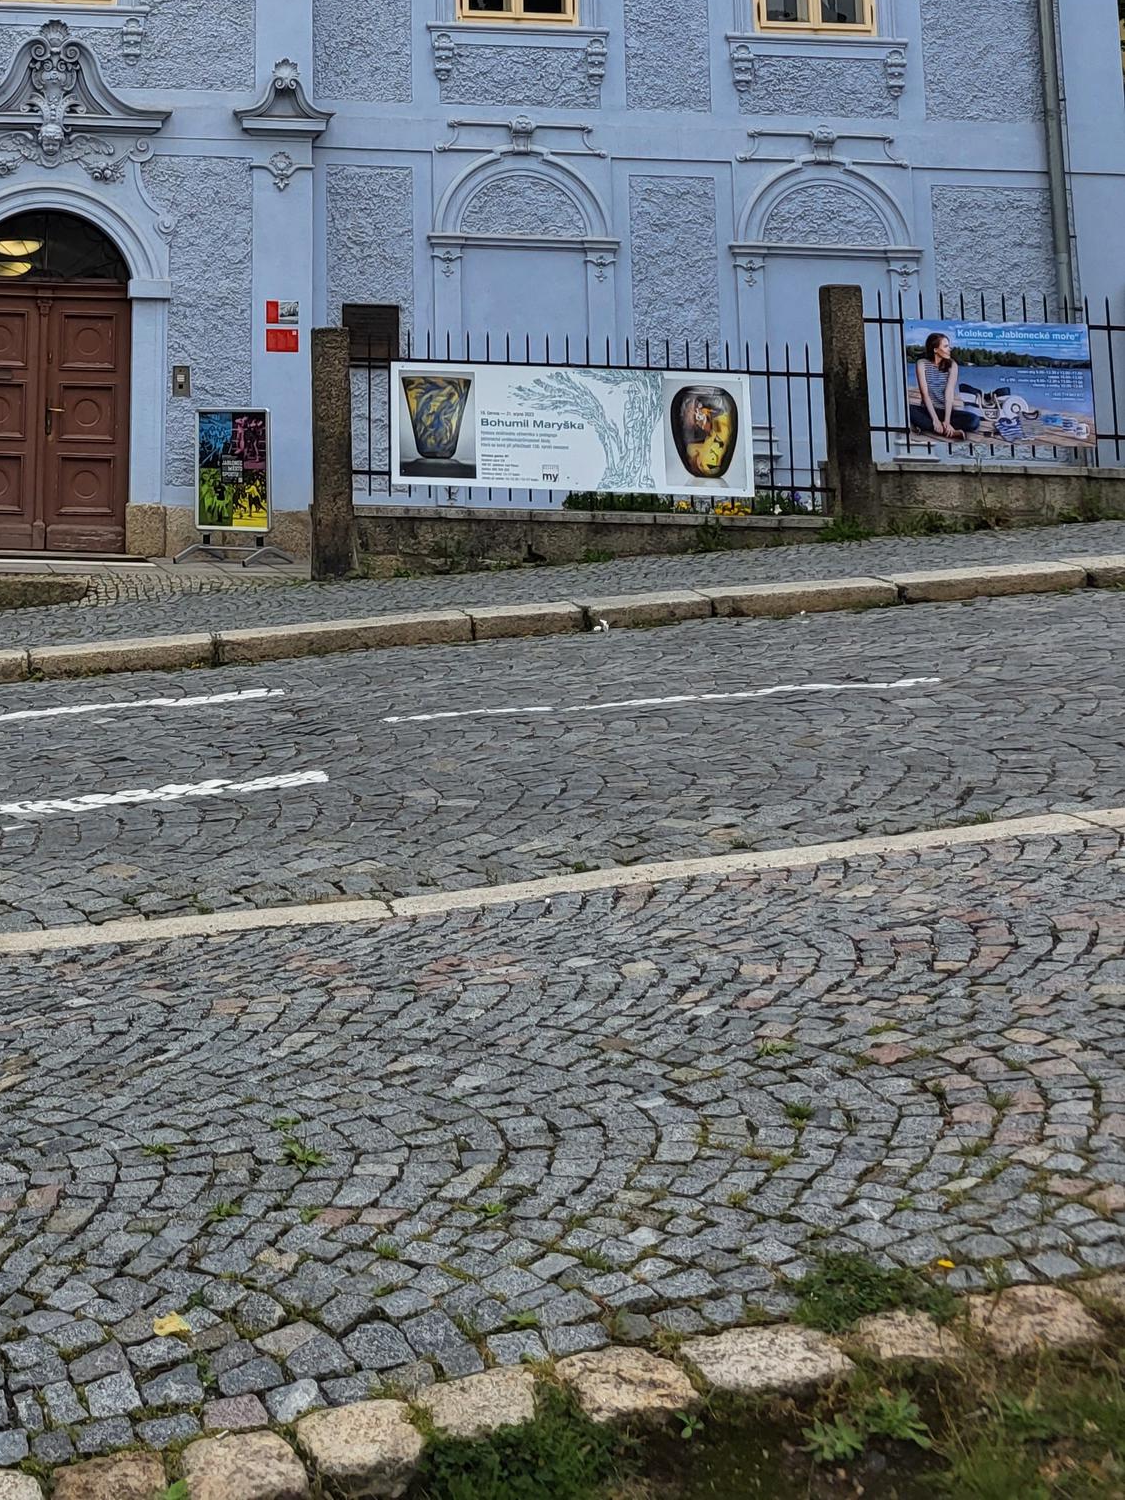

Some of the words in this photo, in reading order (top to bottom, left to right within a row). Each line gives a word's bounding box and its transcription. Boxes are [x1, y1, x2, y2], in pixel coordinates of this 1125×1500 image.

[956, 329, 994, 338] Kolekce
[481, 418, 529, 427] Bohumil
[533, 420, 584, 430] Maryška
[542, 473, 558, 482] my
